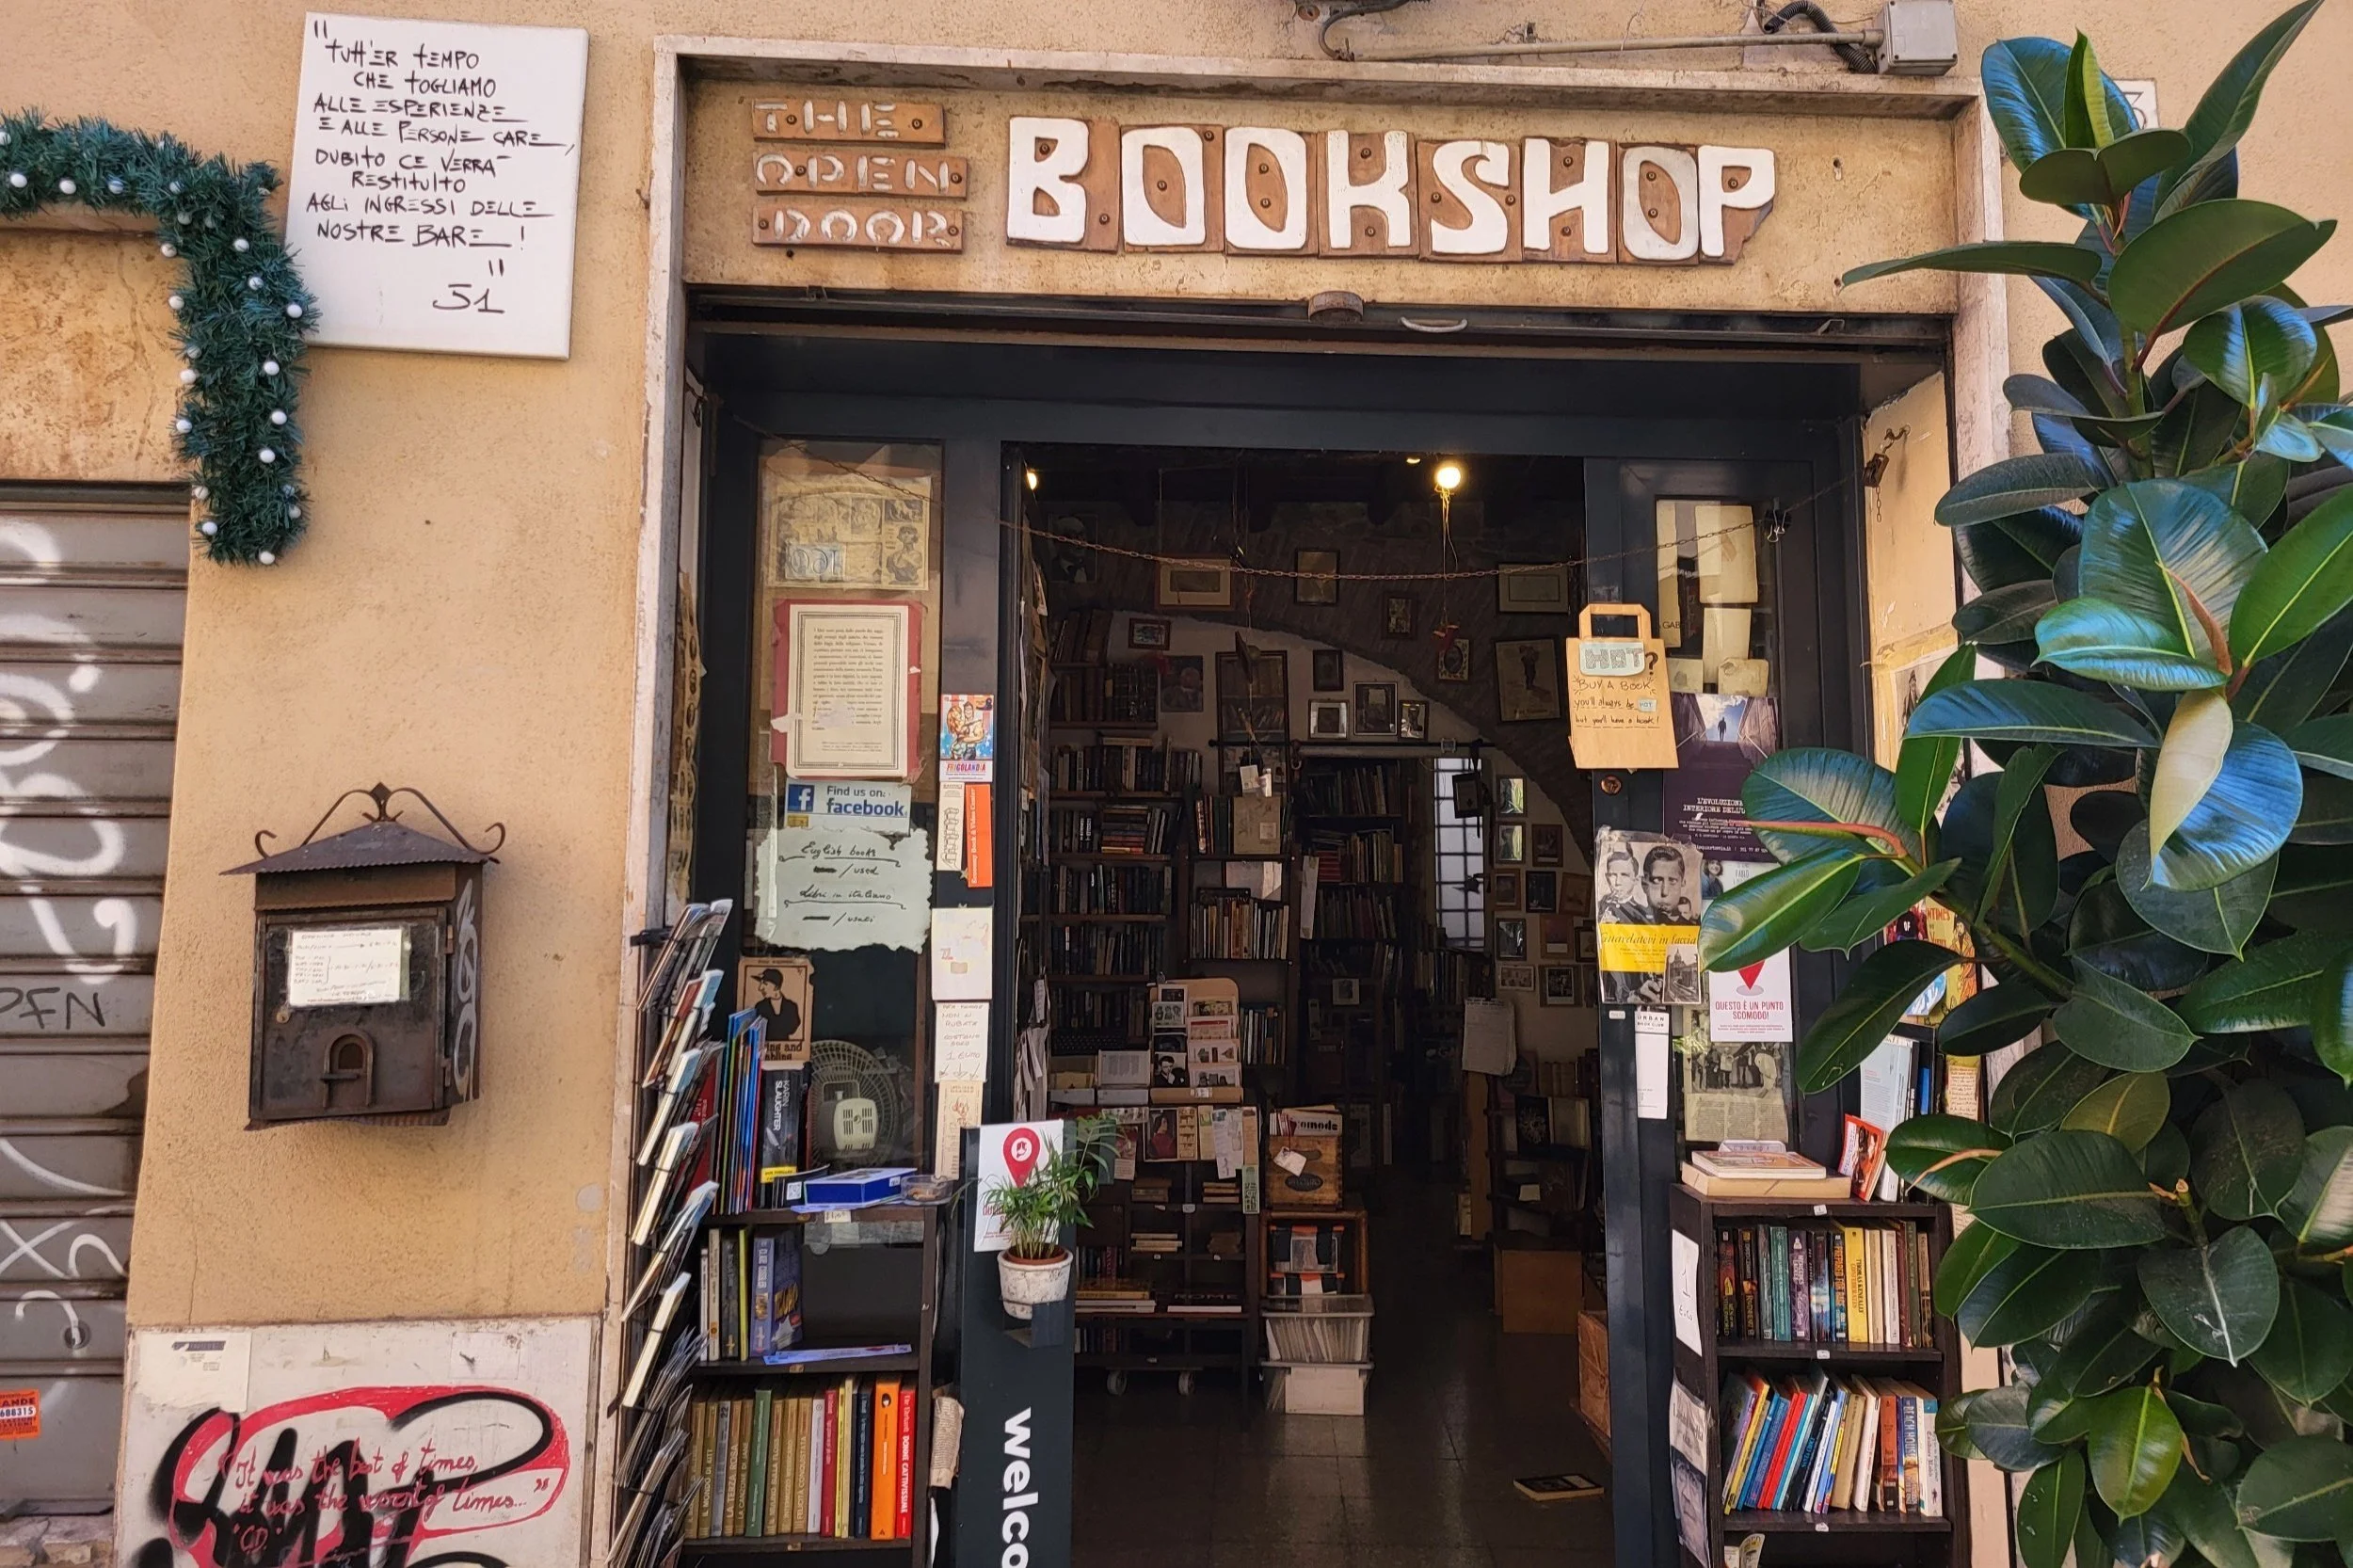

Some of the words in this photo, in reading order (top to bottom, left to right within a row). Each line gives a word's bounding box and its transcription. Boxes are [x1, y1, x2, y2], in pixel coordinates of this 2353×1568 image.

[353, 72, 393, 88] CHE
[313, 93, 366, 113] ALLE
[373, 99, 529, 123] ESPERIENZE
[755, 99, 900, 138] THE
[319, 117, 335, 131] E
[341, 120, 389, 136] ALLE
[398, 120, 486, 146] PERSONE
[316, 146, 386, 168] DUBITO
[399, 154, 428, 169] CE
[757, 153, 949, 194] OPEN
[1009, 117, 1775, 261] BOOKSHOP
[364, 192, 456, 216] INGRESSI
[471, 193, 555, 217] DELLE
[317, 218, 405, 243] NOSTRE
[775, 208, 951, 248] DOOR
[1578, 680, 1602, 690] BUY
[1620, 680, 1650, 691] BOOK
[1575, 696, 1595, 711] you'll
[1598, 696, 1622, 710] always
[1625, 697, 1634, 709] be
[1575, 715, 1588, 724] but
[946, 763, 985, 772] FRIGOLANDIA
[826, 785, 850, 796] Find
[853, 788, 865, 796] us
[826, 799, 905, 816] facebook
[853, 866, 879, 876] used
[848, 888, 891, 901] italiano
[1903, 920, 1911, 932] OF
[1658, 936, 1668, 945] in
[1715, 1001, 1741, 1011] QUESTO
[1743, 1000, 1748, 1011] È
[1750, 1001, 1759, 1011] UN
[1761, 1001, 1785, 1011] PUNTO
[1732, 1011, 1769, 1021] SCOMODO!
[784, 1041, 802, 1051] and
[772, 1080, 783, 1131] SLAUGHTER
[782, 1080, 791, 1107] KARIN
[1903, 1405, 1916, 1430] BEACH
[312, 1446, 342, 1483] the
[392, 1451, 408, 1483] of
[729, 1444, 739, 1470] ROSA
[797, 1435, 807, 1488] CONQUISTATA
[314, 1483, 347, 1512] the
[703, 1478, 712, 1508] MONDO
[728, 1474, 736, 1501] TERZA
[1001, 1406, 1038, 1568] welco
[726, 1506, 735, 1518] LA
